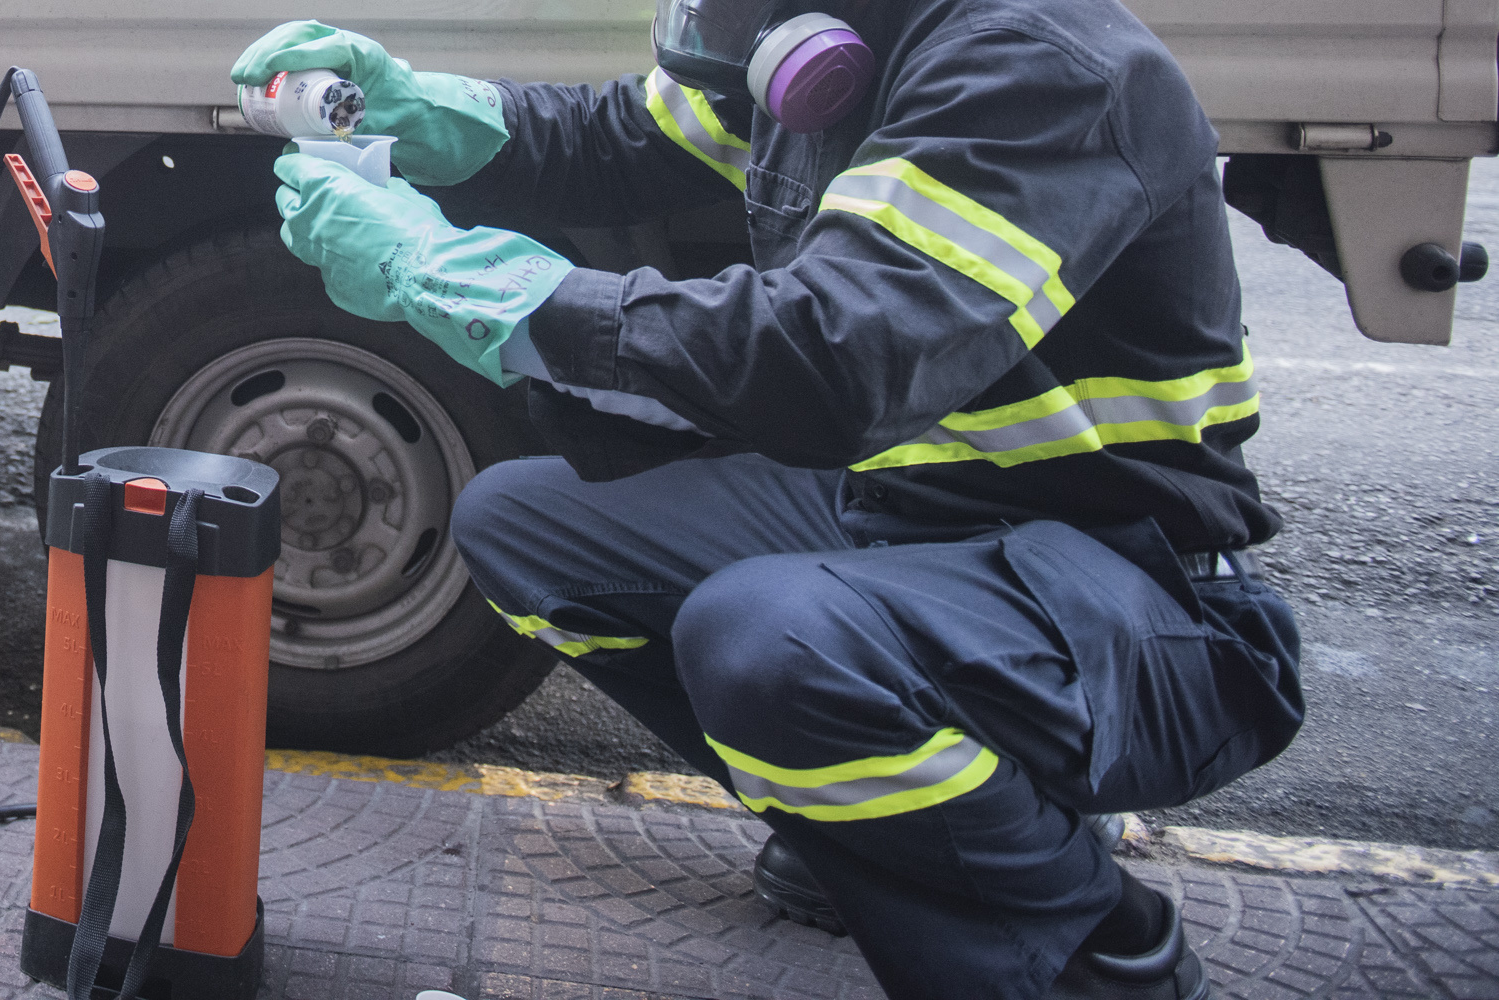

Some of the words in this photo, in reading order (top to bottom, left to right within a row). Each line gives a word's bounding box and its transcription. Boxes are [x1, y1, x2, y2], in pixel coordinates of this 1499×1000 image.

[52, 606, 80, 629] MAX
[63, 636, 79, 653] 5L
[203, 636, 244, 650] MAX
[59, 702, 76, 719] 4L
[56, 767, 72, 784] 3L
[52, 827, 68, 845] 2L
